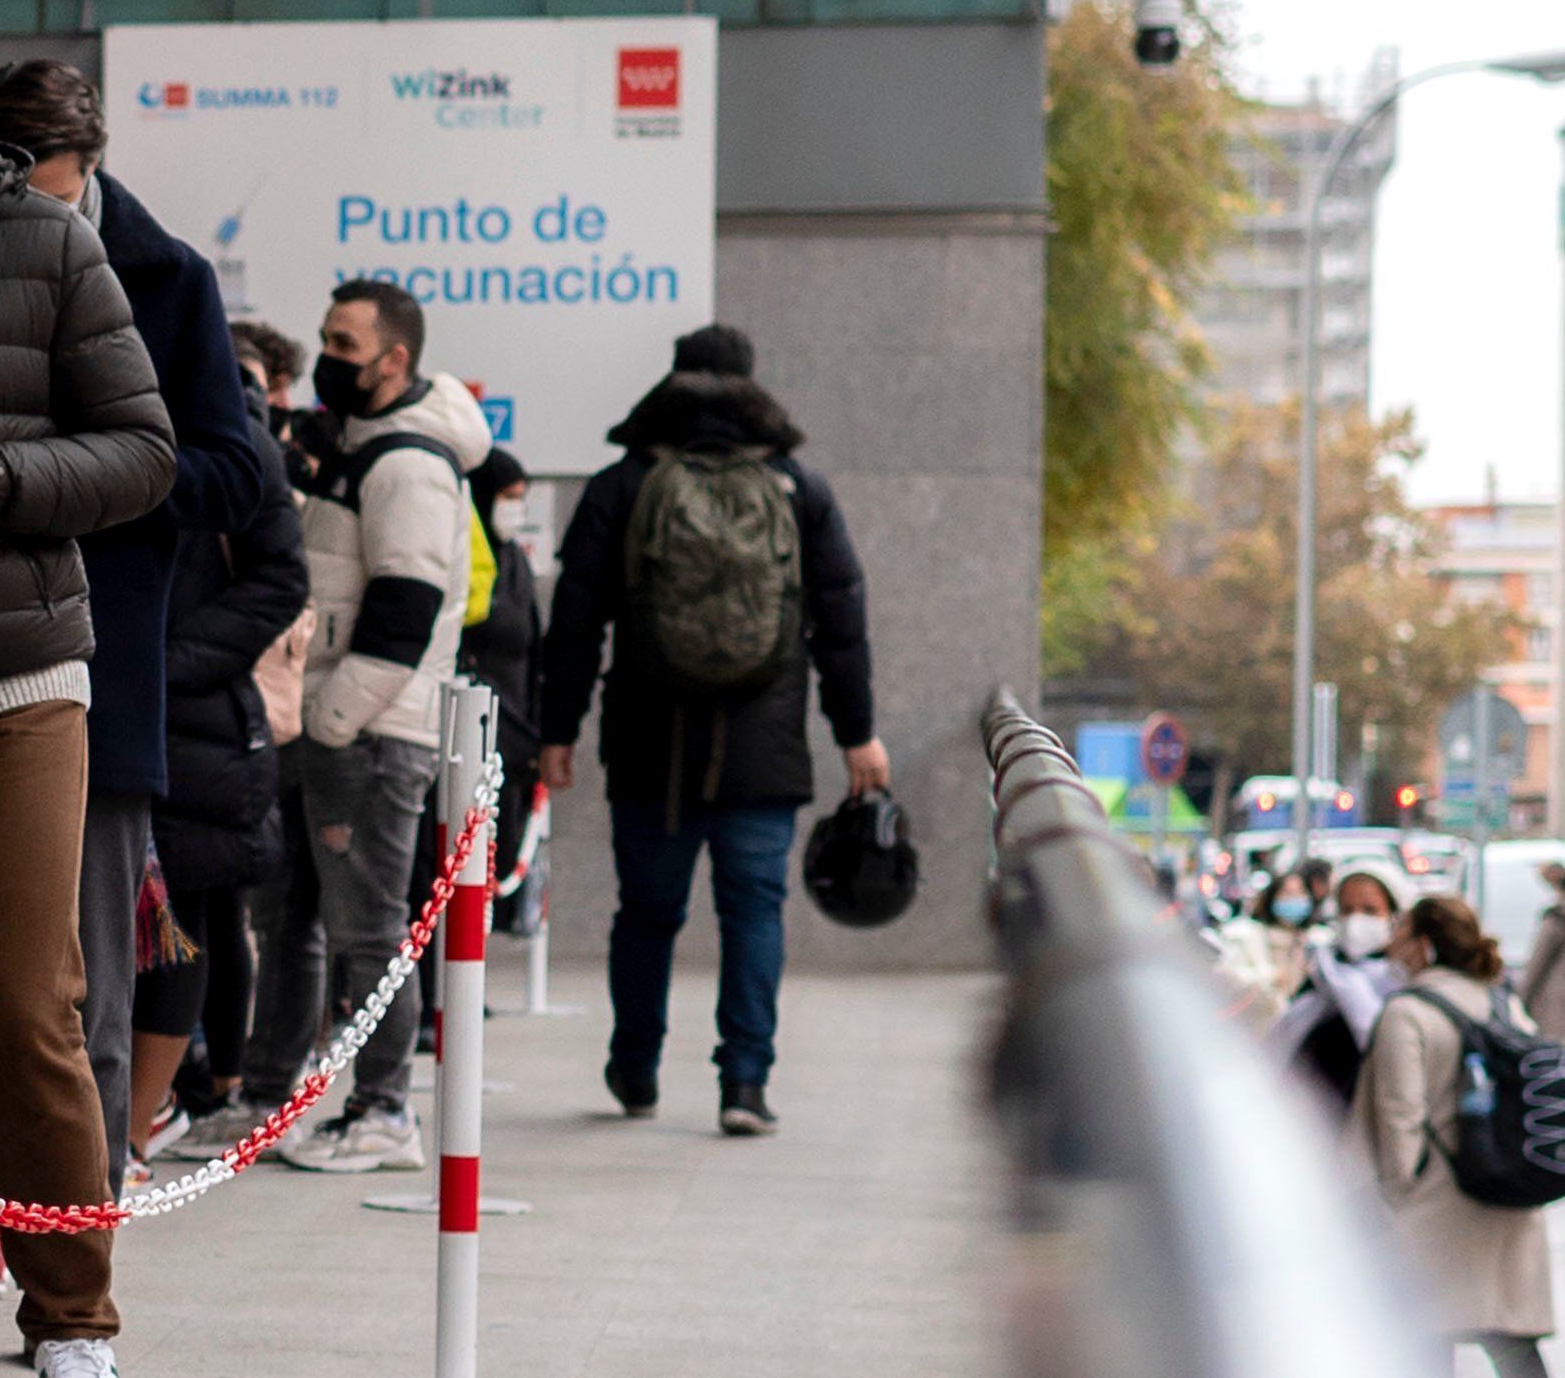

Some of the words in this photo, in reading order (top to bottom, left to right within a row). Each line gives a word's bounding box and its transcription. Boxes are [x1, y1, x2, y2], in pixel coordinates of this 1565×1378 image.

[391, 68, 510, 100] WiZink
[337, 195, 511, 244] Punto
[533, 192, 606, 244] de
